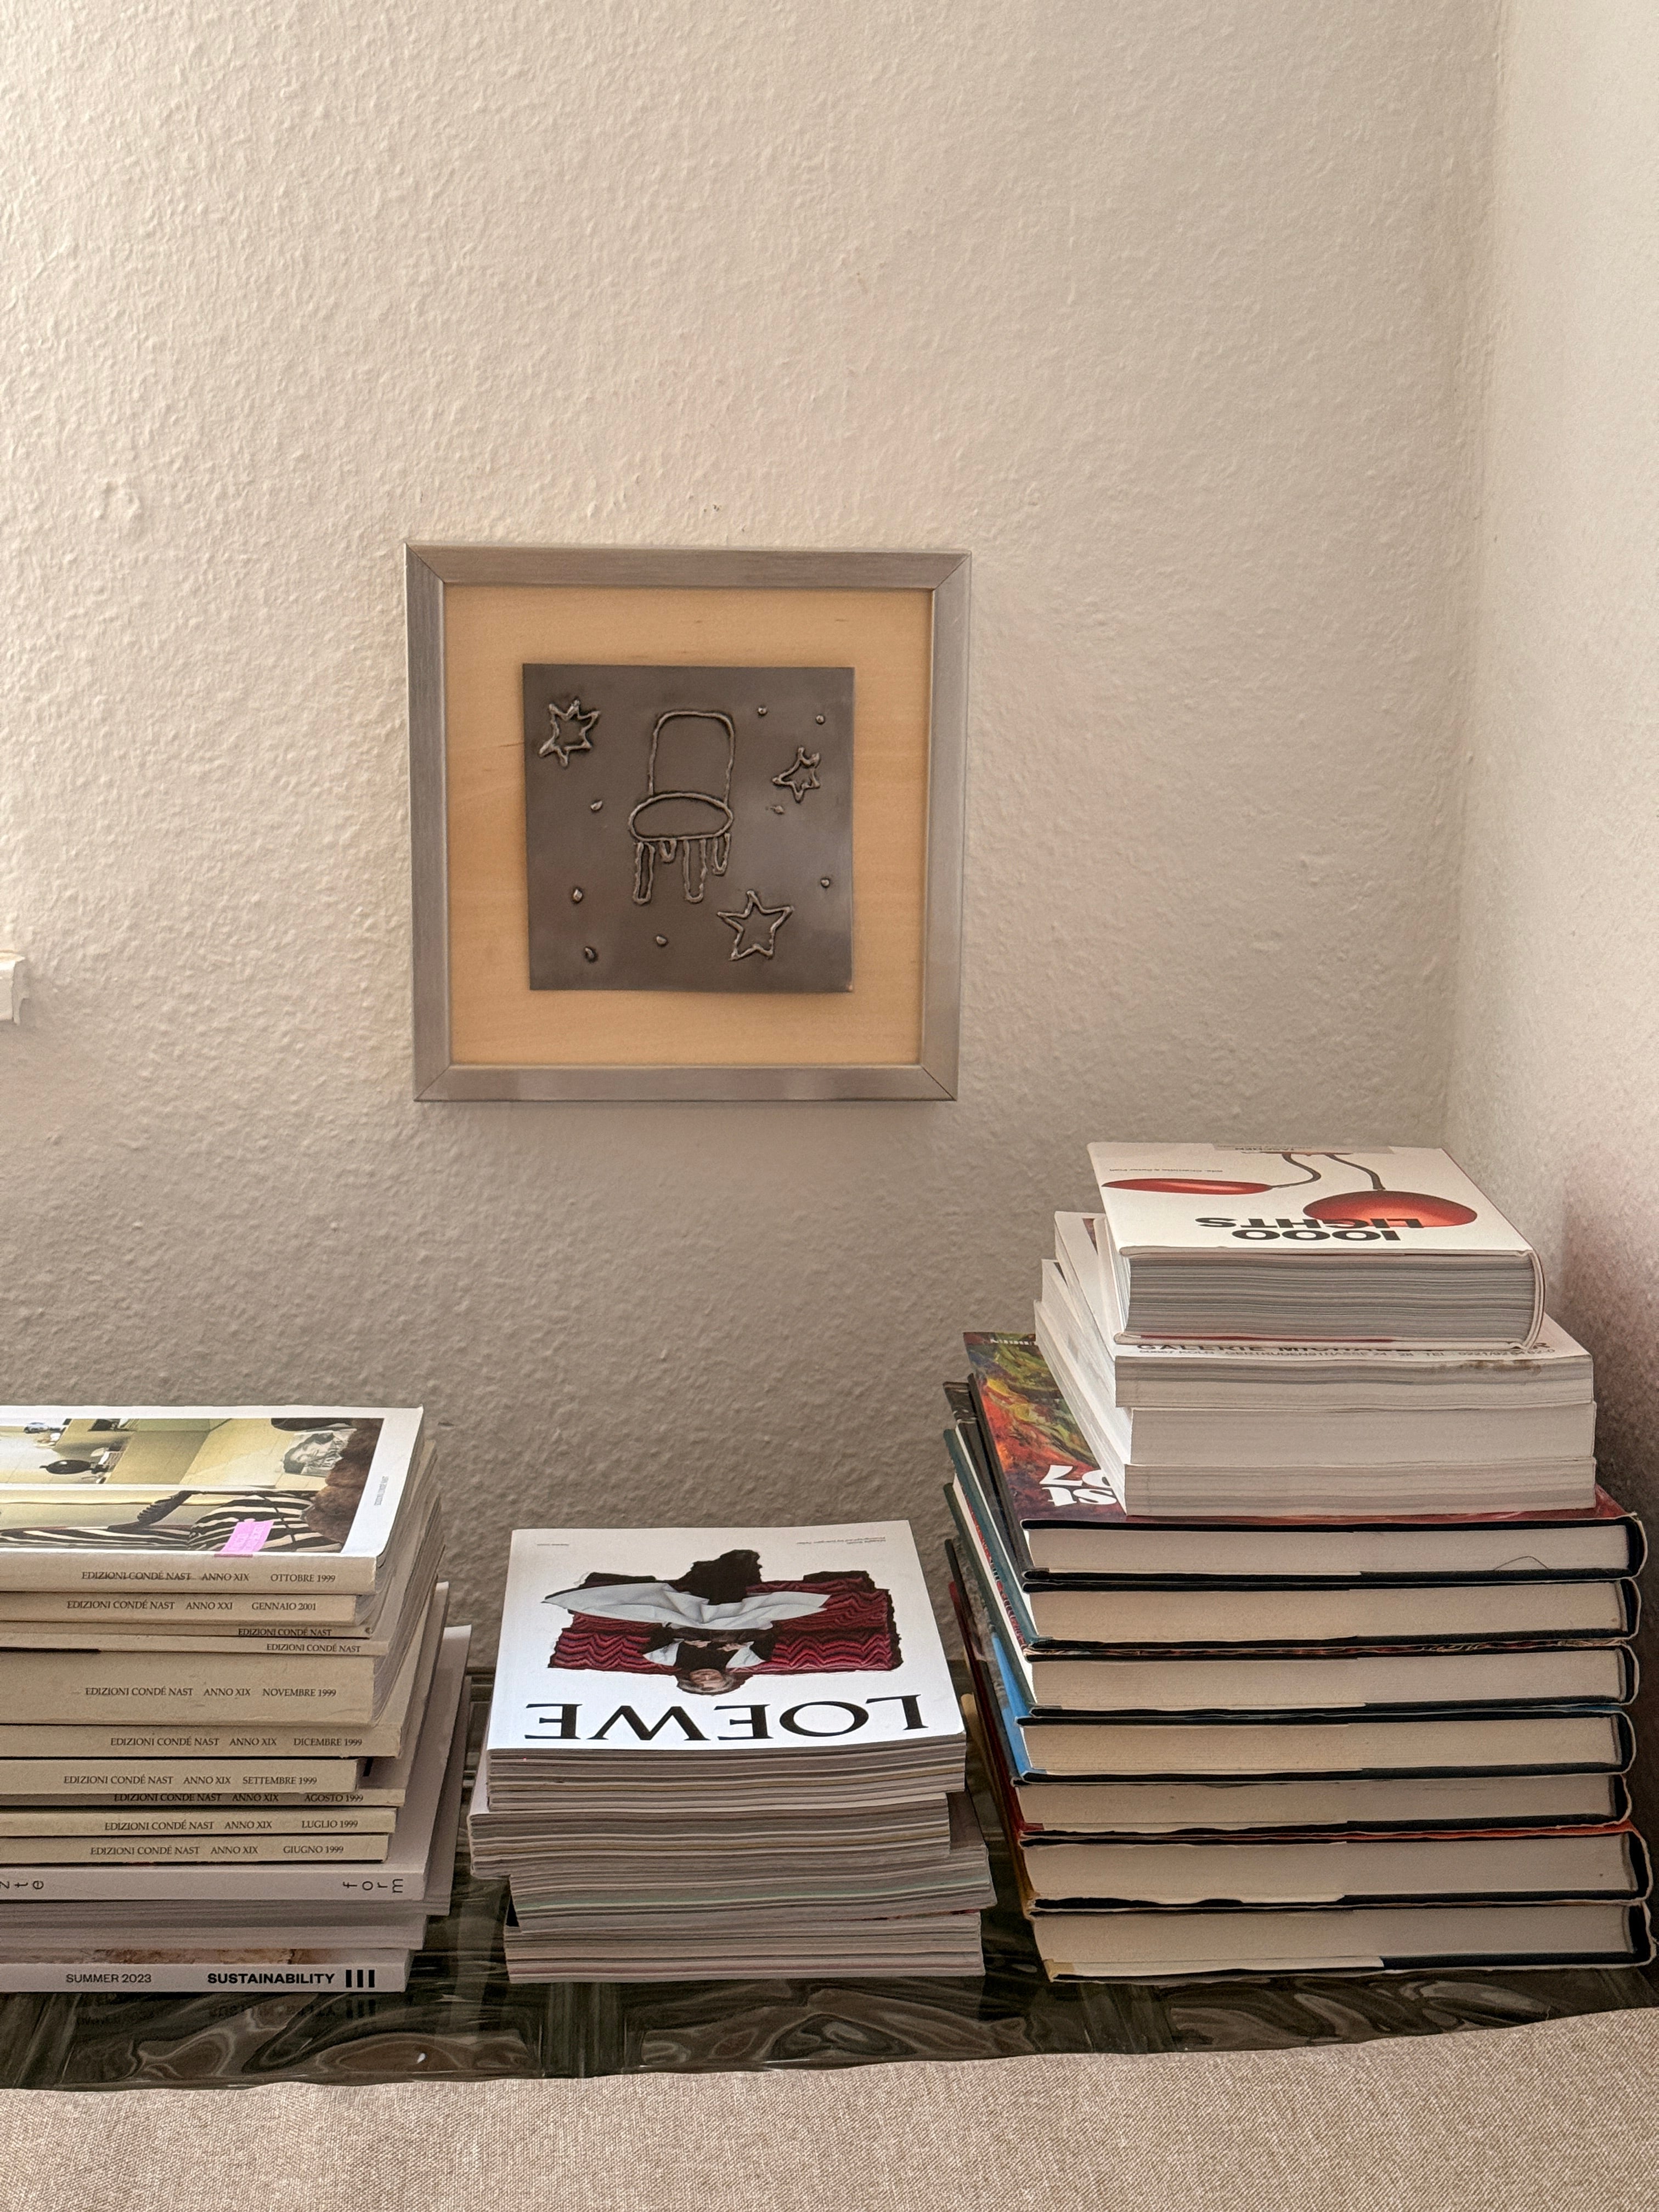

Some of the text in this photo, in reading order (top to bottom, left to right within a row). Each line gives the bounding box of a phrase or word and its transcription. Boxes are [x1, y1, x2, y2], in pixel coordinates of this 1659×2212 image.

[1195, 1217, 1424, 1229] LIGHTS
[1232, 1229, 1402, 1242] 1000
[81, 1571, 336, 1583] EDIZIONI CONDÉ NAST ANNO XIX OTTOBRE 1999
[67, 1599, 316, 1611] EDIZIONI CONDÉ NAST ANNO XXI GENNAIO 2001
[278, 1627, 307, 1637] CONDÉ
[310, 1629, 332, 1637] NAST
[306, 1643, 337, 1652] CONDÉ
[85, 1685, 337, 1697] EDIZIONI CONDÉ NAST ANNO XIX NOVEMBRE 1999
[524, 1695, 929, 1741] LOEWE
[110, 1736, 363, 1746] EDIZIONI CONDÉ NAST ANNO XIX DICEMBRE 1999
[64, 1776, 108, 1784] EDIZIONI
[110, 1774, 146, 1784] CONDÉ
[148, 1776, 174, 1785] NAST
[183, 1776, 214, 1784] ANNO
[215, 1776, 231, 1785] XIX
[242, 1776, 296, 1785] SETTEMBRE
[304, 1794, 343, 1802] AGOSTO
[346, 1794, 364, 1802] 1999
[104, 1822, 149, 1831] EDIZIONI
[151, 1819, 187, 1830] CONDÉ
[188, 1821, 213, 1830] NAST
[224, 1821, 255, 1830] ANNO
[256, 1821, 272, 1829] XIX
[302, 1820, 338, 1829] LUGLIO
[90, 1847, 134, 1855] EDIZIONI
[137, 1844, 172, 1855] CONDÉ
[174, 1846, 199, 1855] NAST
[210, 1846, 241, 1854] ANNO
[283, 1846, 323, 1854] GIUGNO
[326, 1846, 344, 1854] 1999
[342, 1878, 403, 1893] form
[66, 1973, 151, 1983] SUMMER 2023
[207, 1973, 335, 1984] SUSTAINABILITY
